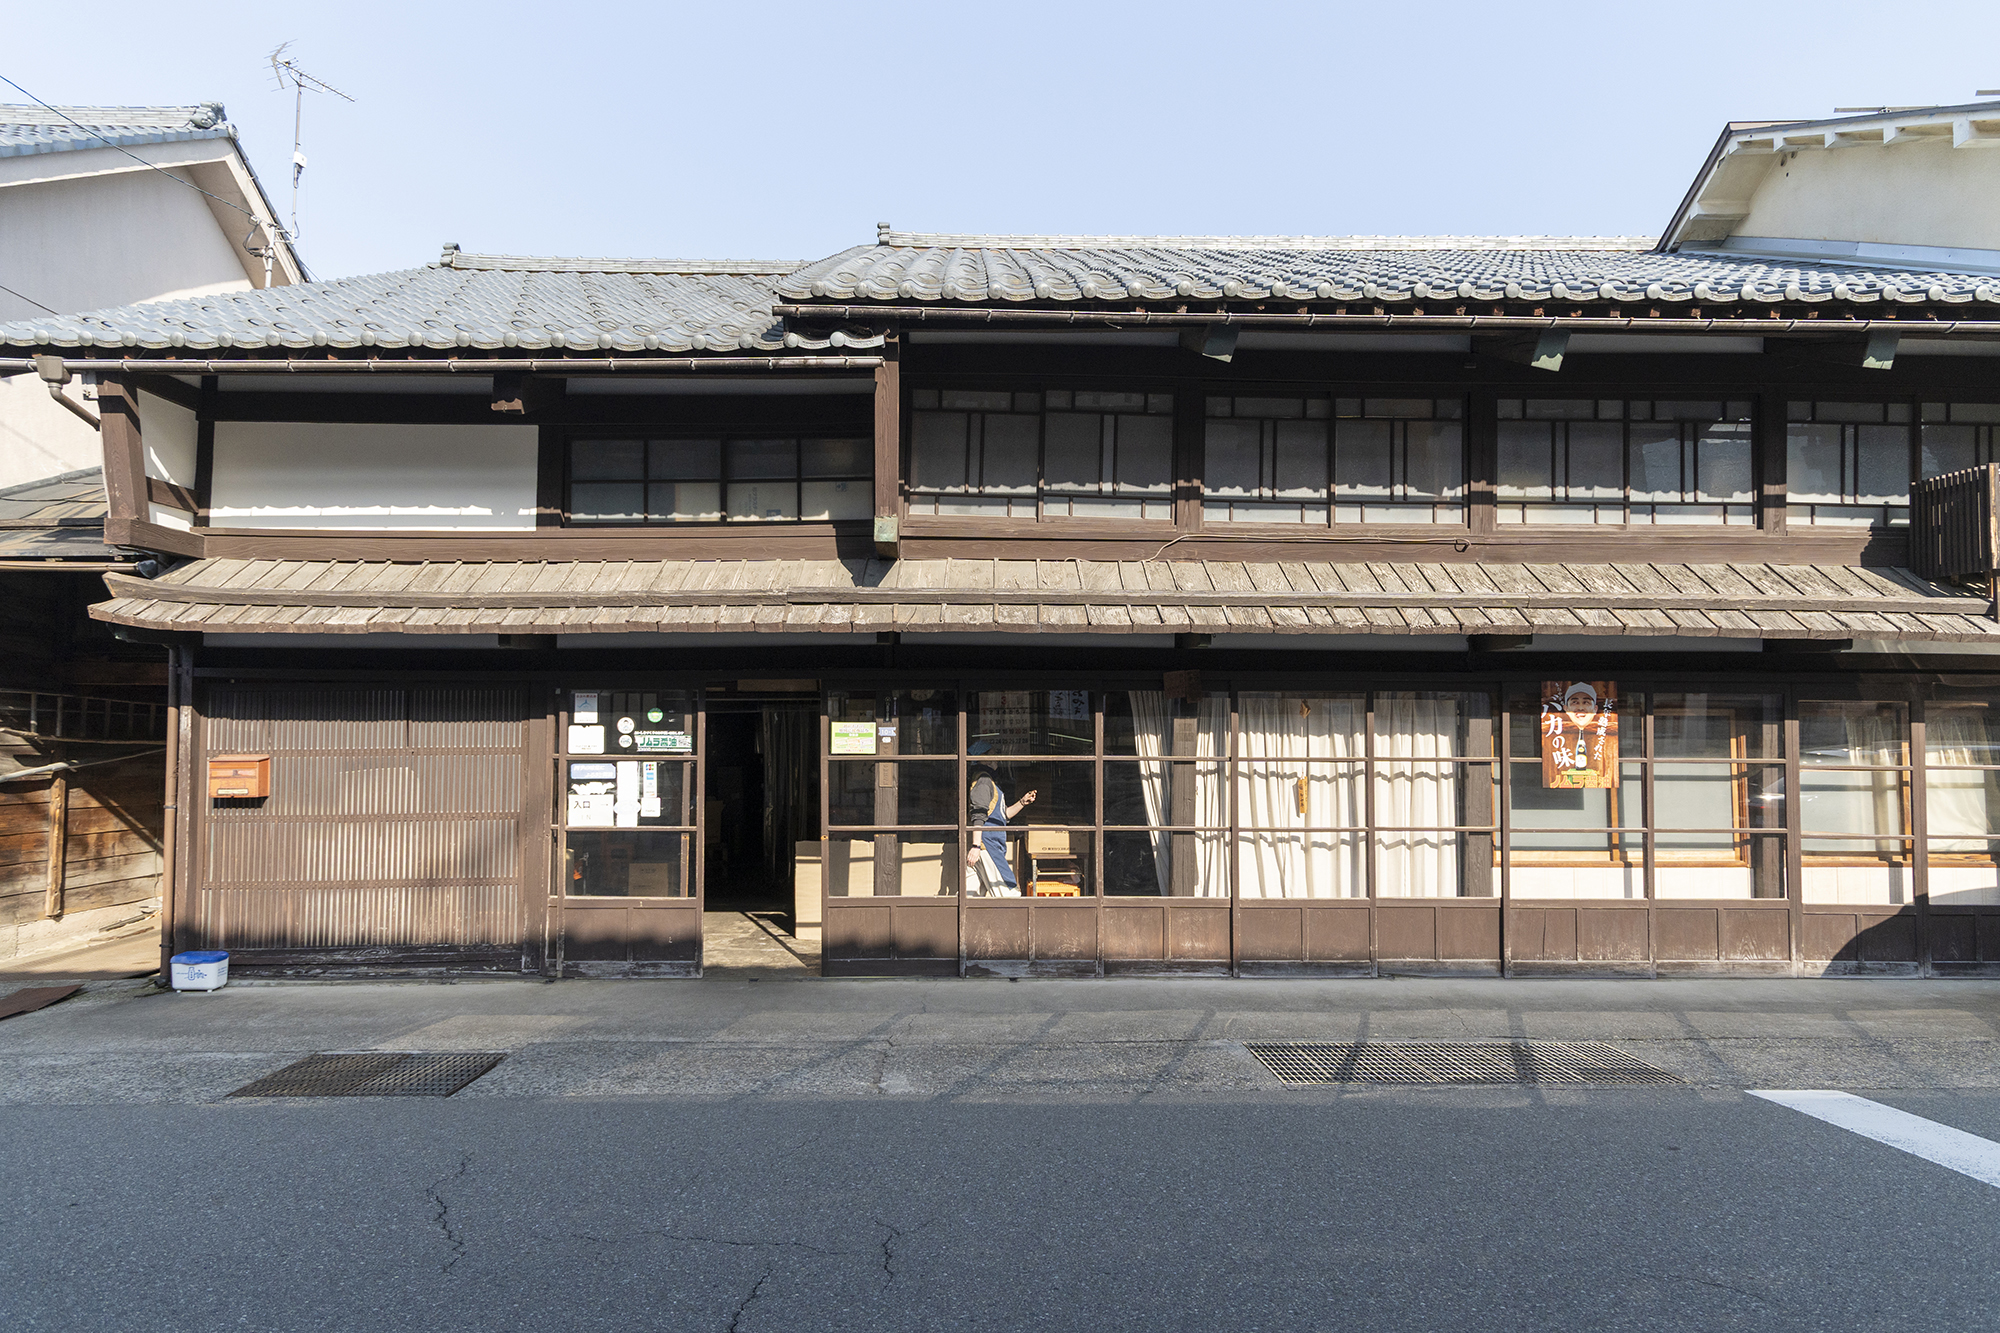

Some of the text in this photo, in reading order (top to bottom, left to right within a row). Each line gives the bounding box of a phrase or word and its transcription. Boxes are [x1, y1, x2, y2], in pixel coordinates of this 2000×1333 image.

[1001, 696, 1006, 705] 3
[1541, 694, 1576, 769] バカの味
[1550, 774, 1611, 788] ノムラ醤油
[573, 800, 590, 809] 入口
